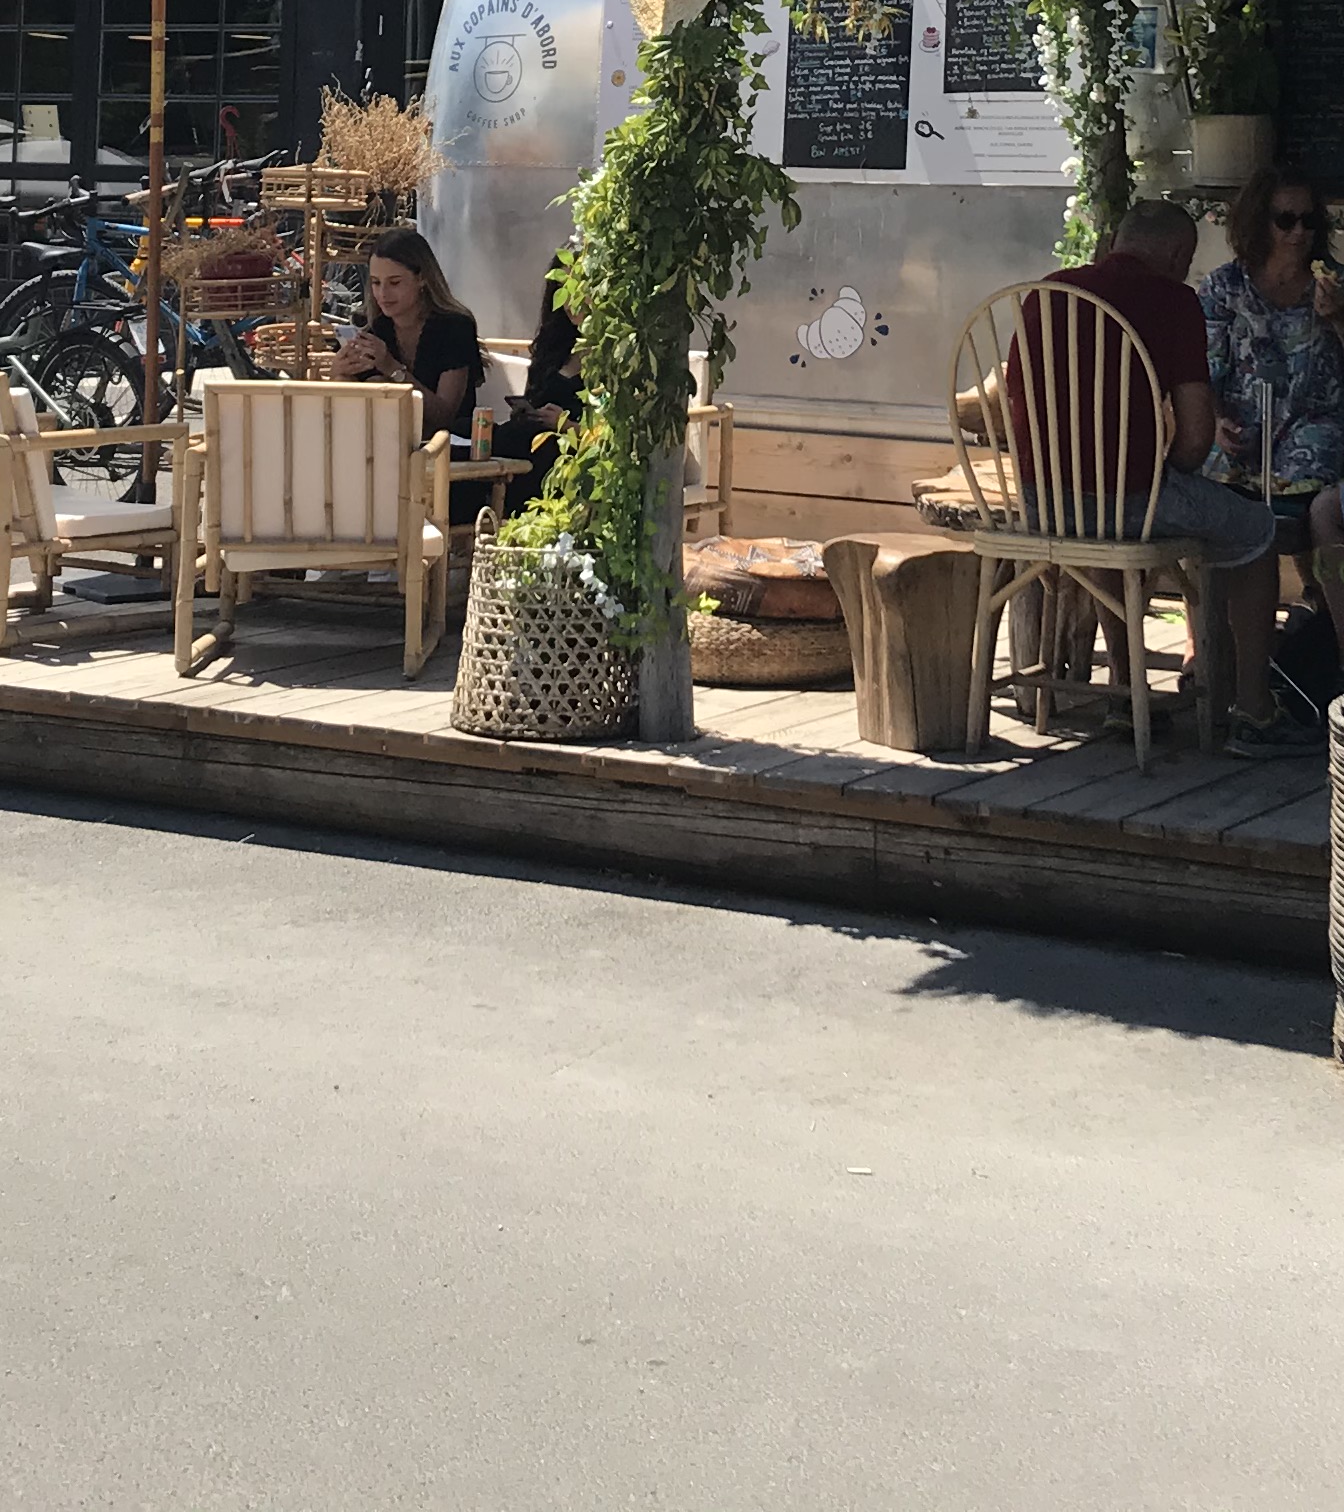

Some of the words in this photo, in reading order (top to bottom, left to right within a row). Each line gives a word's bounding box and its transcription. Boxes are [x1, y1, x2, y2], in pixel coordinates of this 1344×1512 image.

[448, 37, 466, 73] AUX
[520, 1, 558, 70] D'ABORD
[466, 109, 499, 129] COFFEE
[503, 107, 527, 128] SHOP
